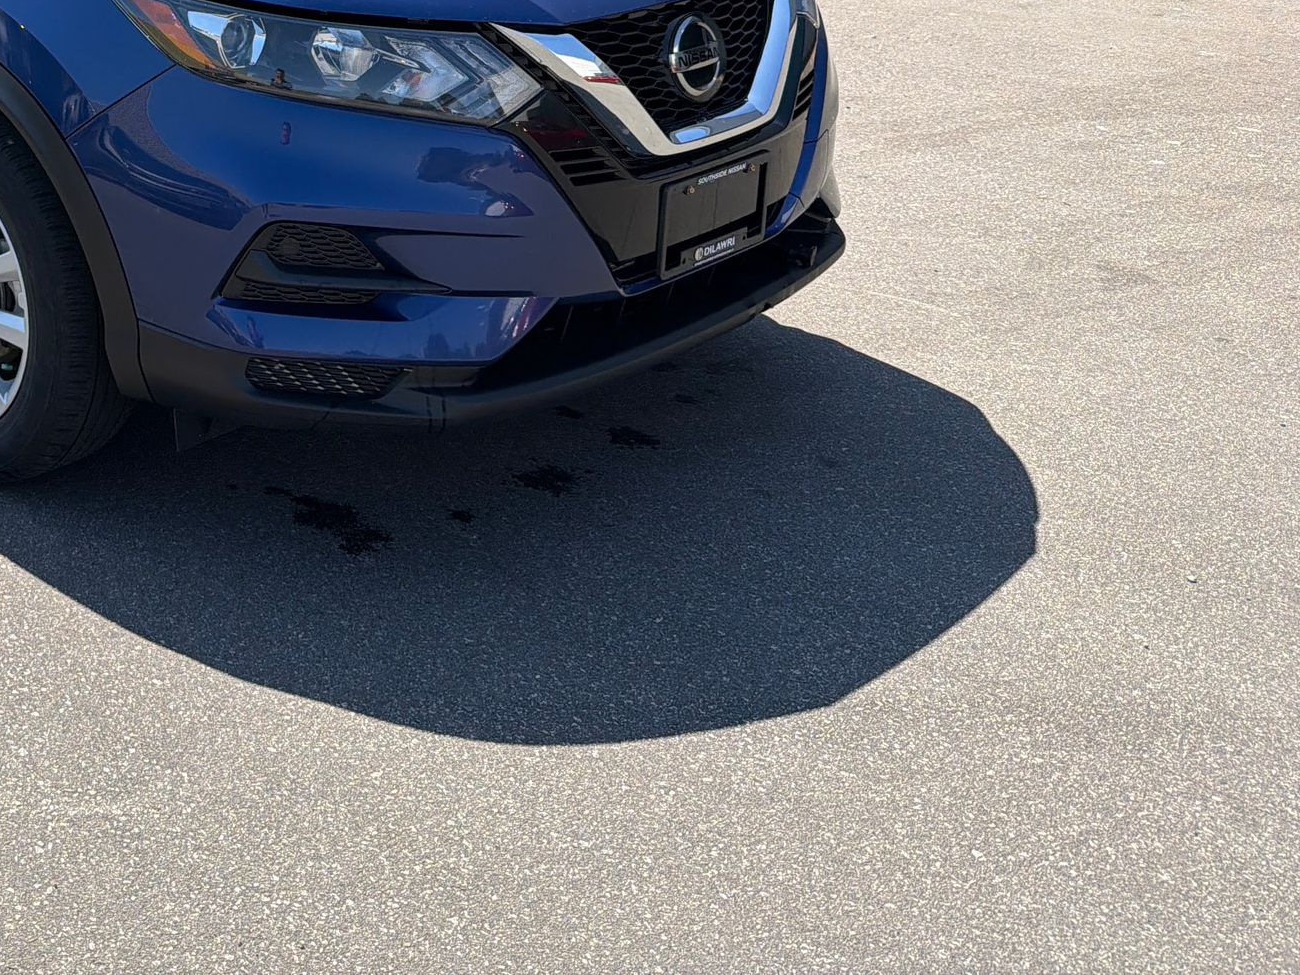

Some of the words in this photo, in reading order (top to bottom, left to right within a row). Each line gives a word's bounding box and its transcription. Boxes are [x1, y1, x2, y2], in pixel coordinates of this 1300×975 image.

[678, 46, 718, 67] NISSAN
[697, 169, 728, 185] SOUTHSIDE
[728, 161, 747, 175] NISSAN
[704, 236, 736, 256] DILAWRI
